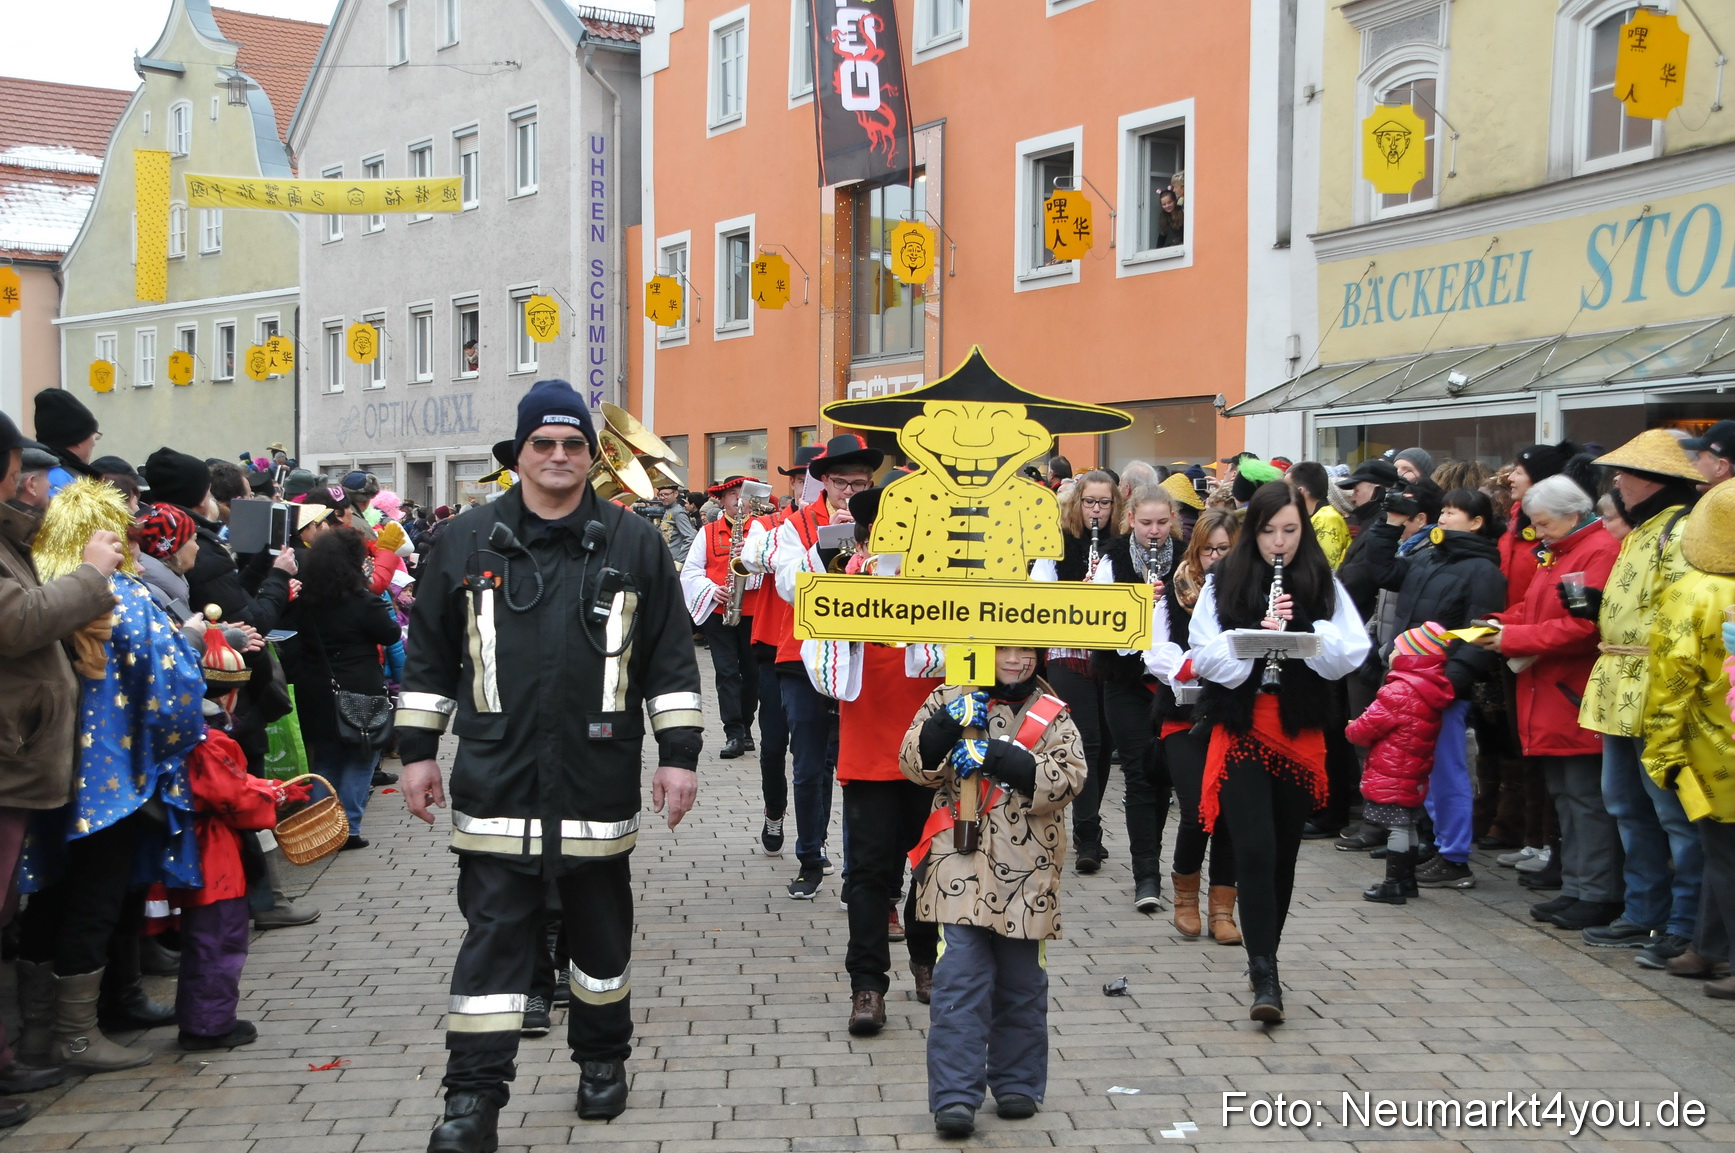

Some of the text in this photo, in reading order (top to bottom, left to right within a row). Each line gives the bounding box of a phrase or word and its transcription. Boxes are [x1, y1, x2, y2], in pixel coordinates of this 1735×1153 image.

[589, 135, 605, 409] UHREN SCHMUCK
[1339, 202, 1735, 329] BÄCKEREI STO
[364, 392, 480, 440] OPTIK OEXL
[813, 595, 1128, 632] Stadtkapelle Riedenburg
[963, 651, 977, 681] 1
